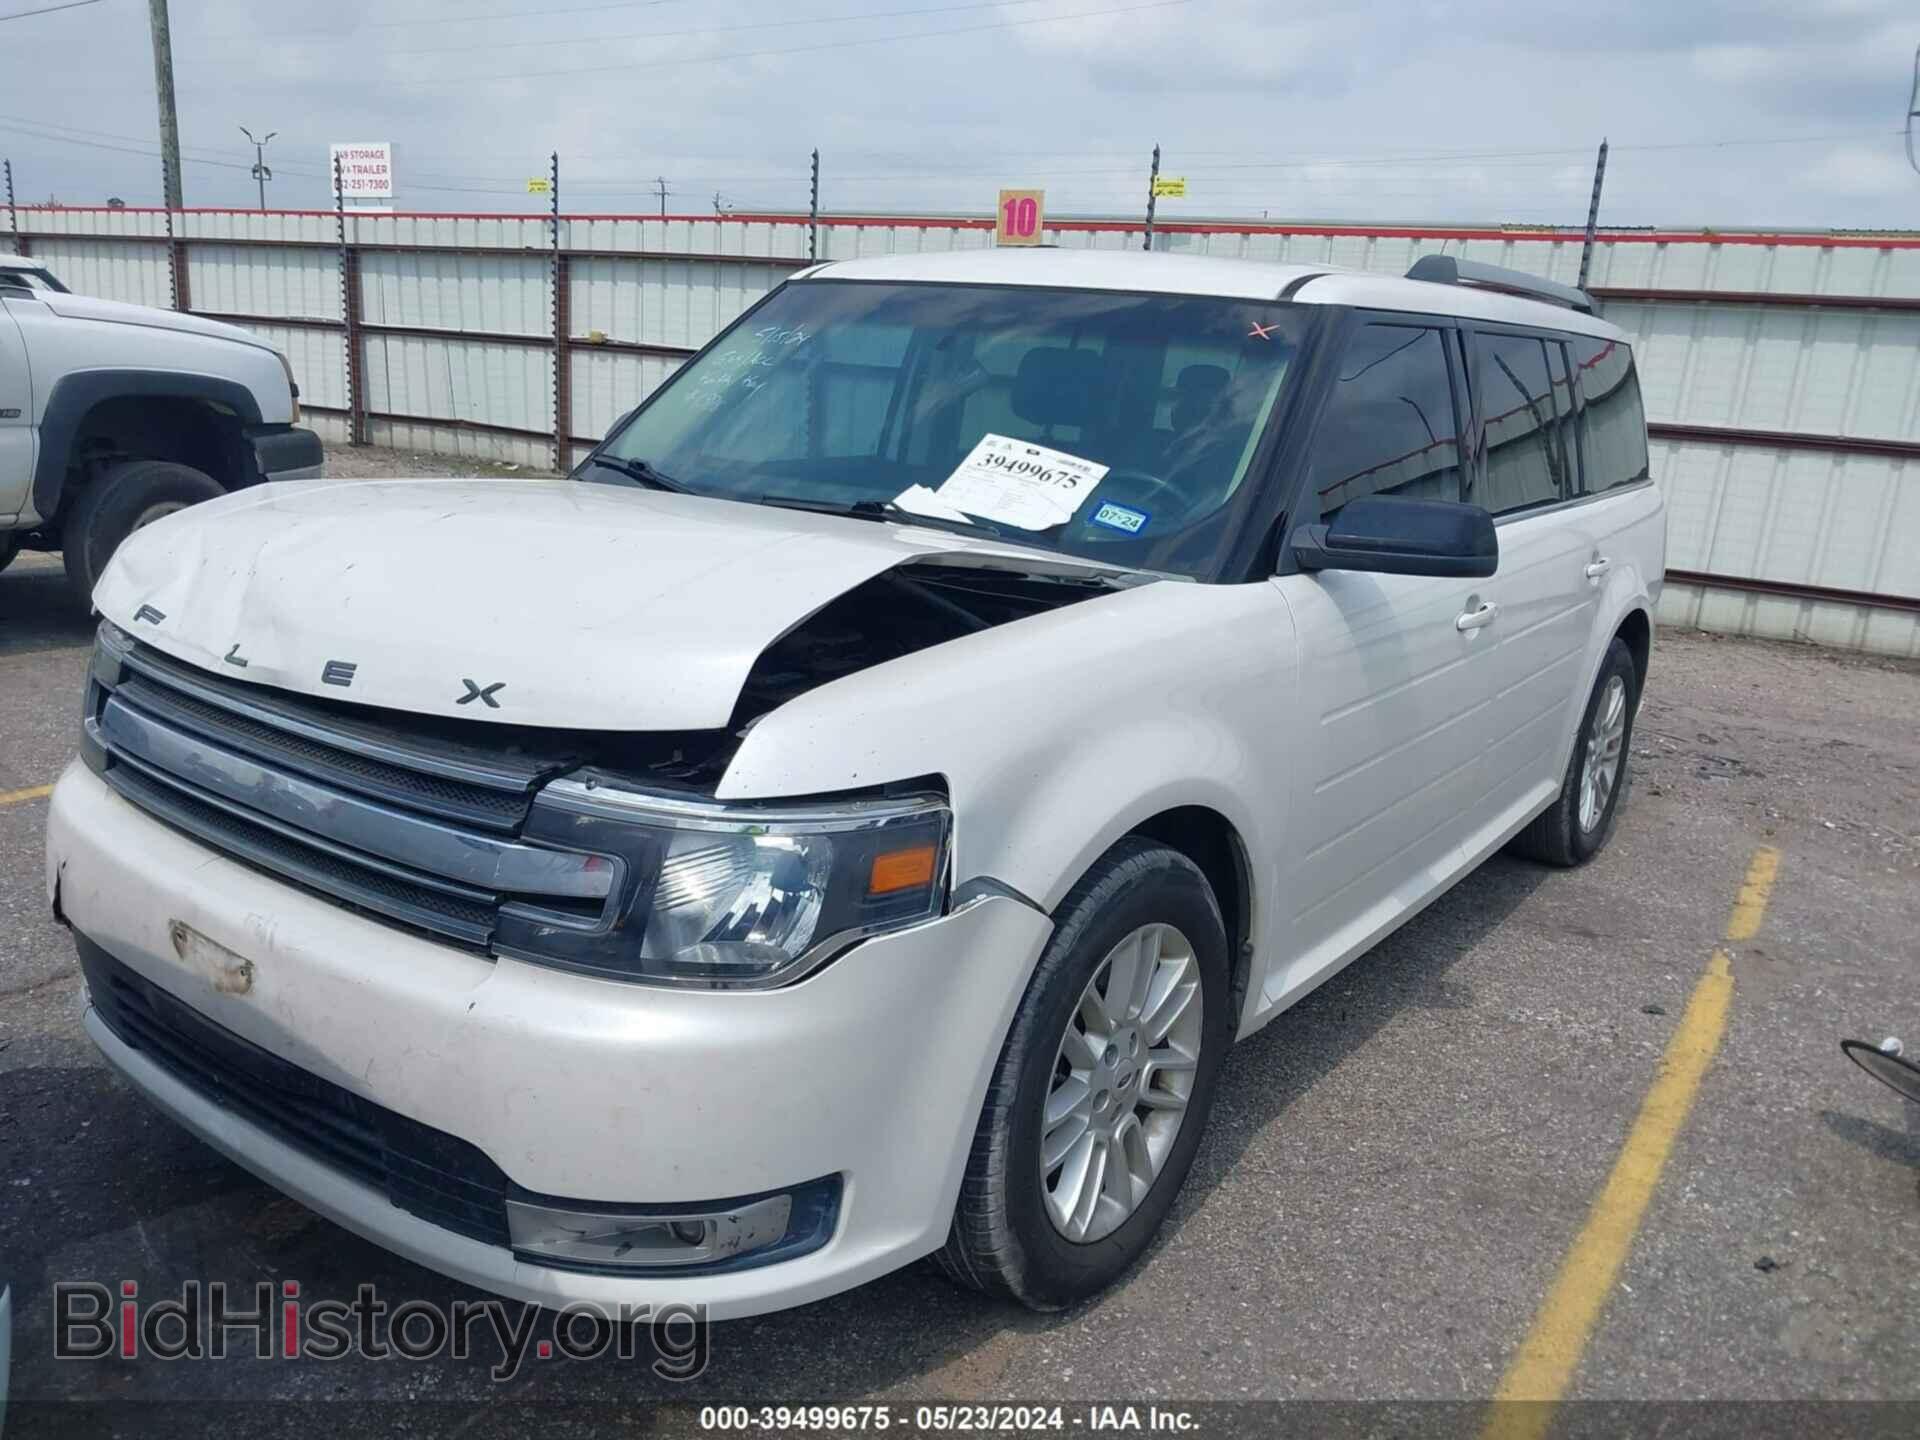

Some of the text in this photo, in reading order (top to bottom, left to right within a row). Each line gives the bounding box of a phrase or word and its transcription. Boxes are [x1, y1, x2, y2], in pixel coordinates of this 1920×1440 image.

[351, 150, 385, 160] STORAGE
[352, 165, 388, 175] TRAILER
[1003, 198, 1037, 237] 10
[977, 453, 1082, 489] 39499675
